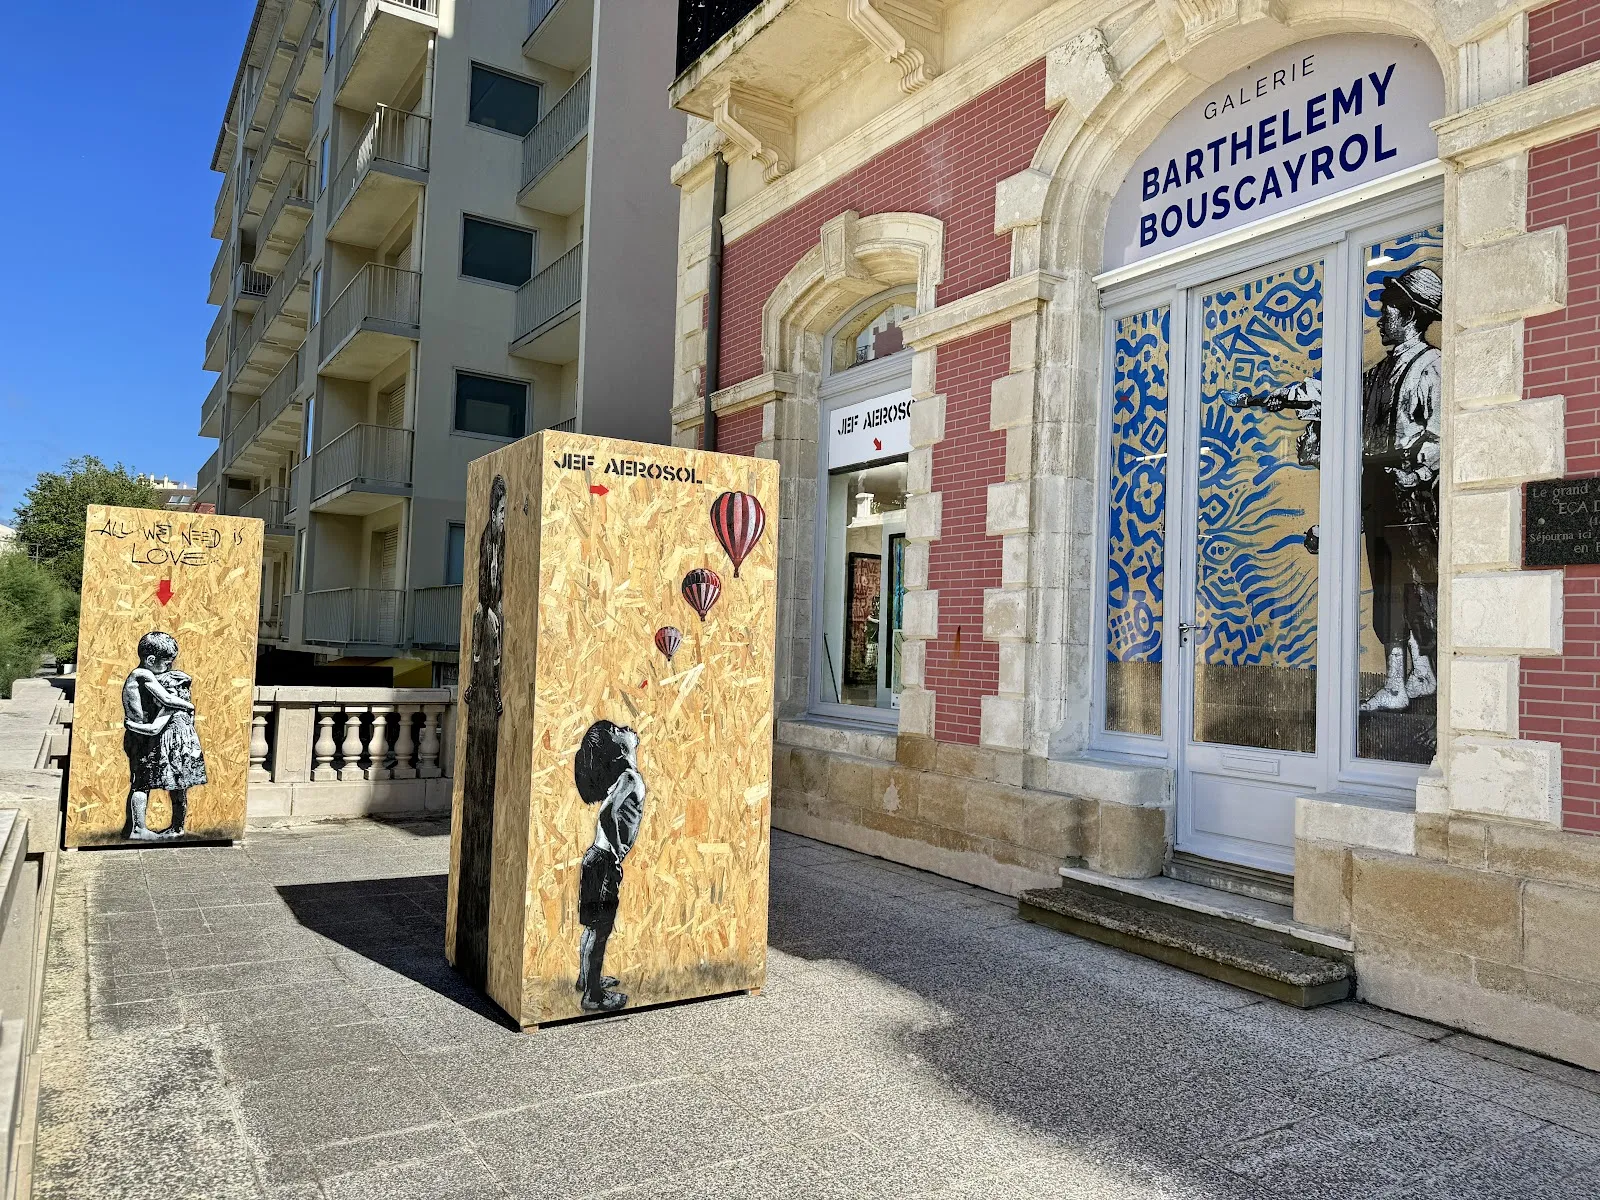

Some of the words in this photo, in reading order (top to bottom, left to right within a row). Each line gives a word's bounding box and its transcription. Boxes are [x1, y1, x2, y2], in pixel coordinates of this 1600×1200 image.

[1204, 54, 1315, 120] GALERIE
[1142, 62, 1397, 202] BARTHELEMY
[1139, 123, 1398, 248] BOUSCAYROL
[837, 414, 859, 436] JEF
[553, 452, 595, 471] JEF
[604, 458, 703, 484] AEROSOL
[1532, 488, 1547, 498] Le
[1552, 483, 1589, 505] grand
[1558, 500, 1589, 515] EÇA
[91, 519, 134, 539] ALL
[142, 522, 172, 544] WE
[181, 521, 221, 549] NEED
[1529, 532, 1574, 545] Séjourna
[1573, 544, 1589, 553] en
